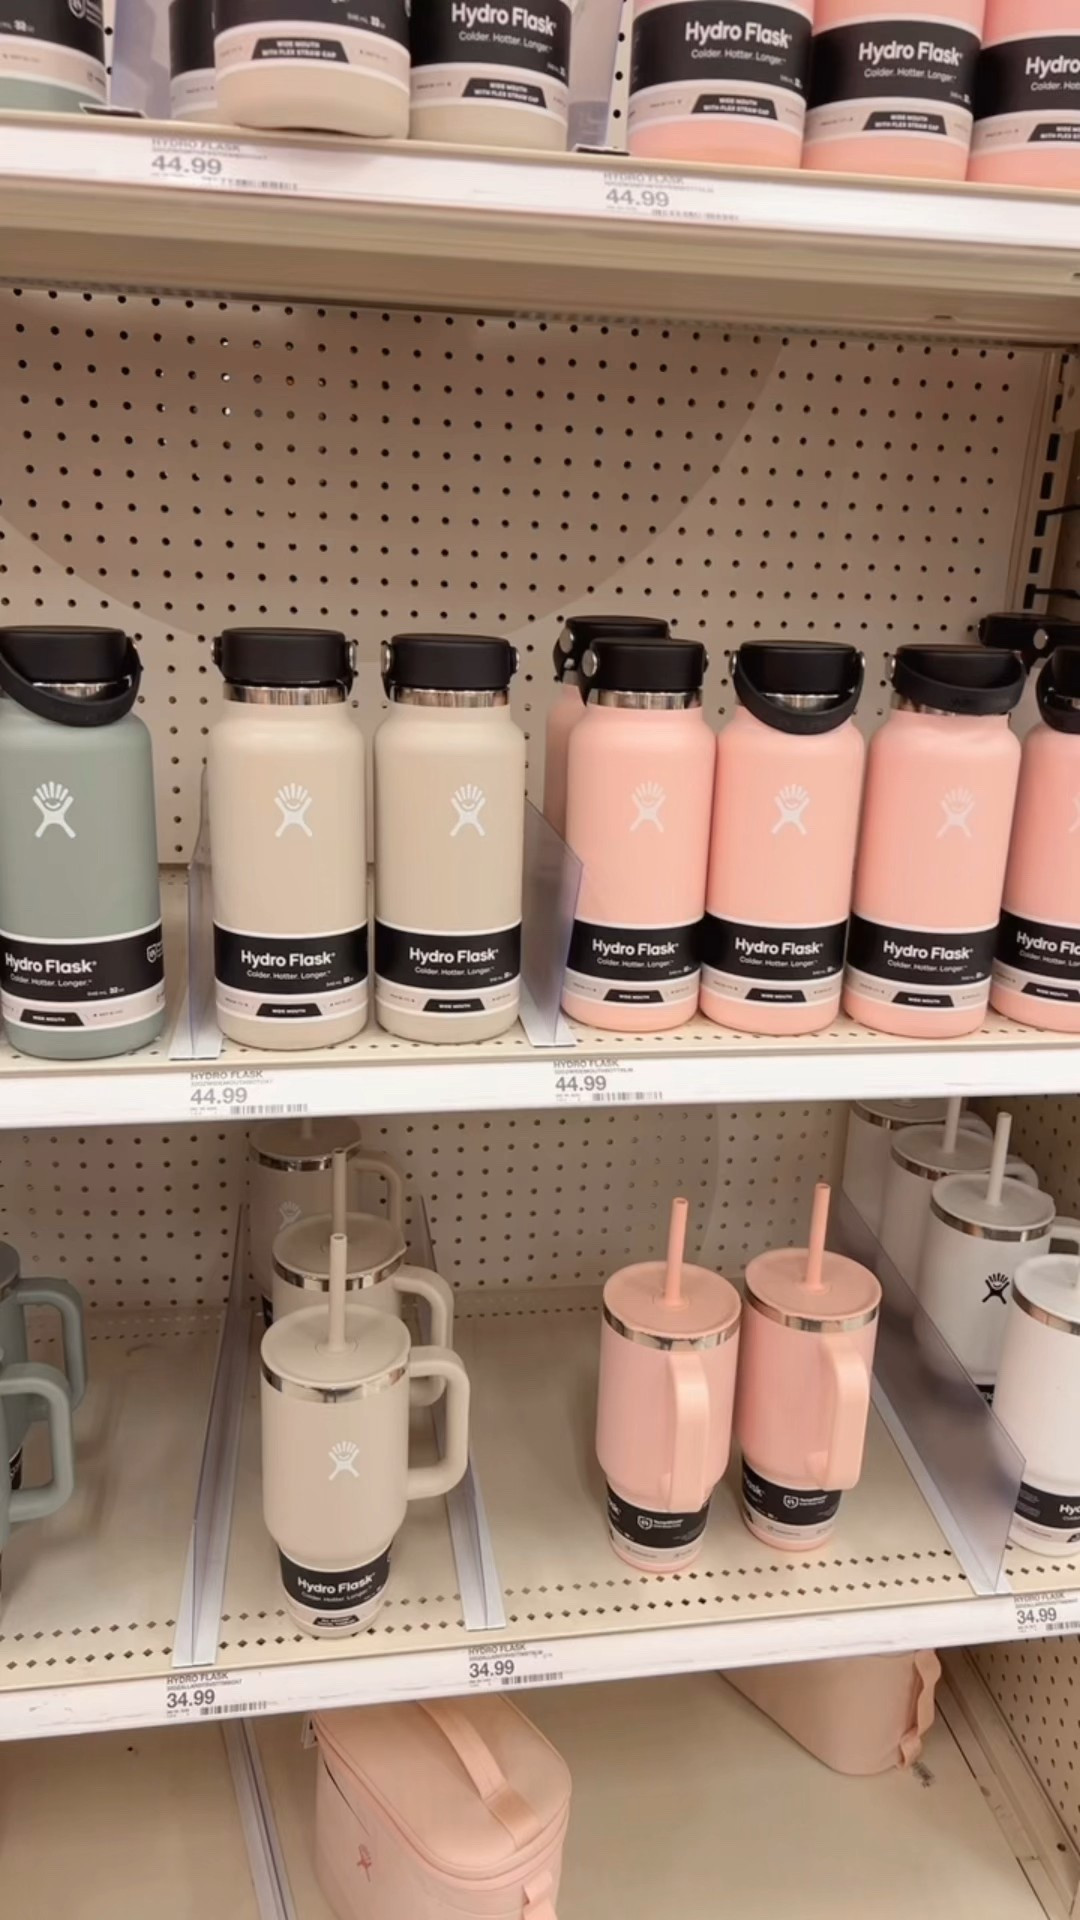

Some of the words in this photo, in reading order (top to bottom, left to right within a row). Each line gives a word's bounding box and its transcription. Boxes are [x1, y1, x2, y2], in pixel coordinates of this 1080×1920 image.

[451, 2, 509, 28] Hydro
[512, 6, 554, 36] Flask
[685, 20, 742, 46] Hydro
[745, 22, 789, 49] Flask
[858, 40, 914, 65] Hydro
[918, 41, 960, 66] Flask
[1025, 54, 1080, 79] Hydro
[152, 155, 222, 175] 44.99
[606, 188, 670, 207] 44.99
[592, 938, 635, 956] Hydro
[637, 942, 675, 956] Flask
[735, 937, 779, 955] Hydro
[782, 941, 820, 955] Flask
[883, 940, 928, 959] Hydro
[931, 946, 970, 960] Flask
[1016, 930, 1058, 952] Hydro
[5, 952, 42, 972] Hydro
[45, 959, 92, 974] Flask
[241, 949, 286, 969] Hydro
[289, 951, 332, 967] Flask
[409, 946, 454, 965] Hydro
[457, 947, 495, 963] Flask
[555, 1075, 606, 1091] 44.99
[190, 1087, 248, 1104] 44.99
[297, 1576, 335, 1593] Hydro
[1016, 1607, 1057, 1625] 34.99
[469, 1659, 514, 1678] 34.99
[167, 1689, 215, 1708] 34.99
